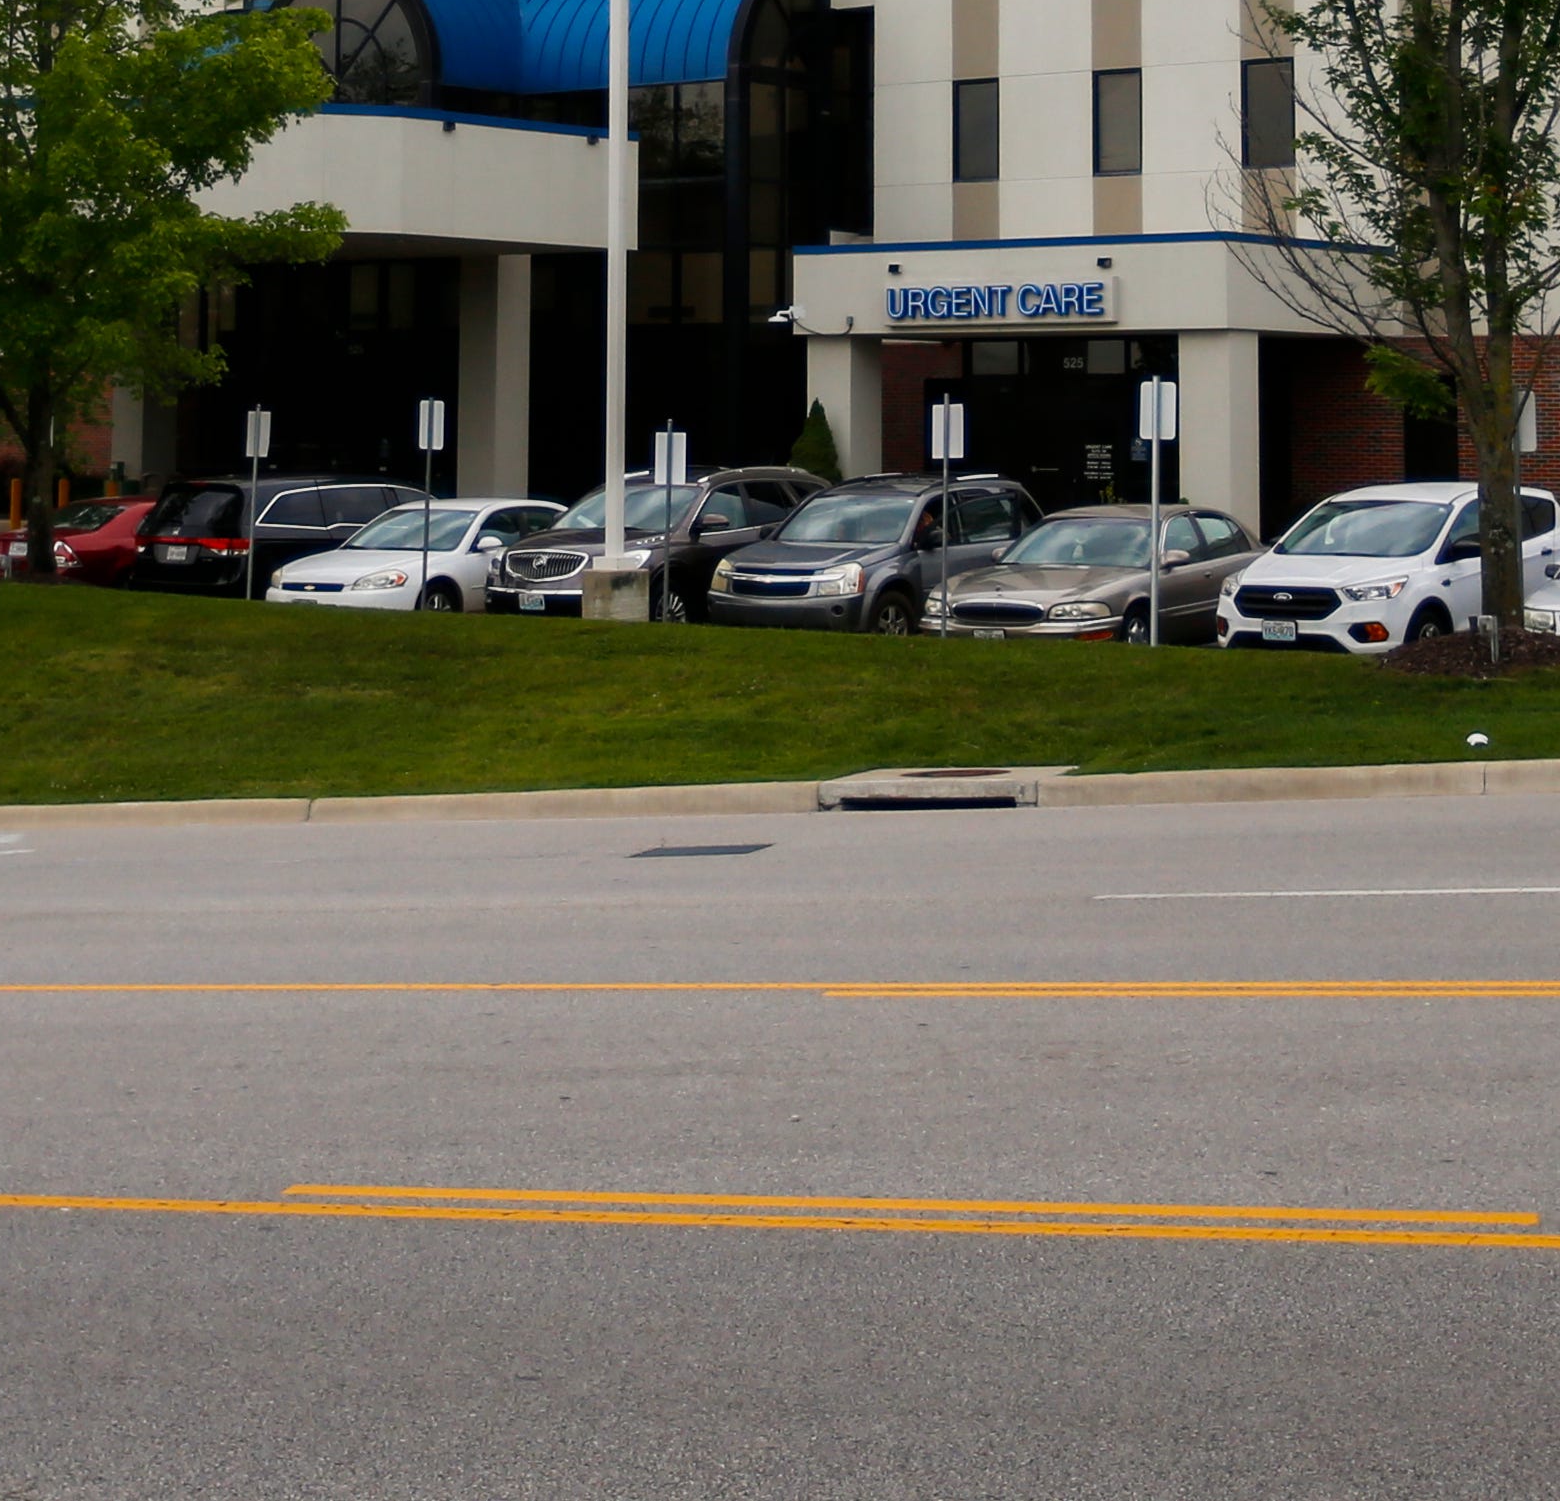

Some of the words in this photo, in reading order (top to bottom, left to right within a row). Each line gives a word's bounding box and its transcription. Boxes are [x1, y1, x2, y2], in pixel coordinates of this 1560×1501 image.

[886, 285, 1012, 320] URGENT
[1017, 282, 1104, 316] CARE
[1062, 356, 1085, 369] 525
